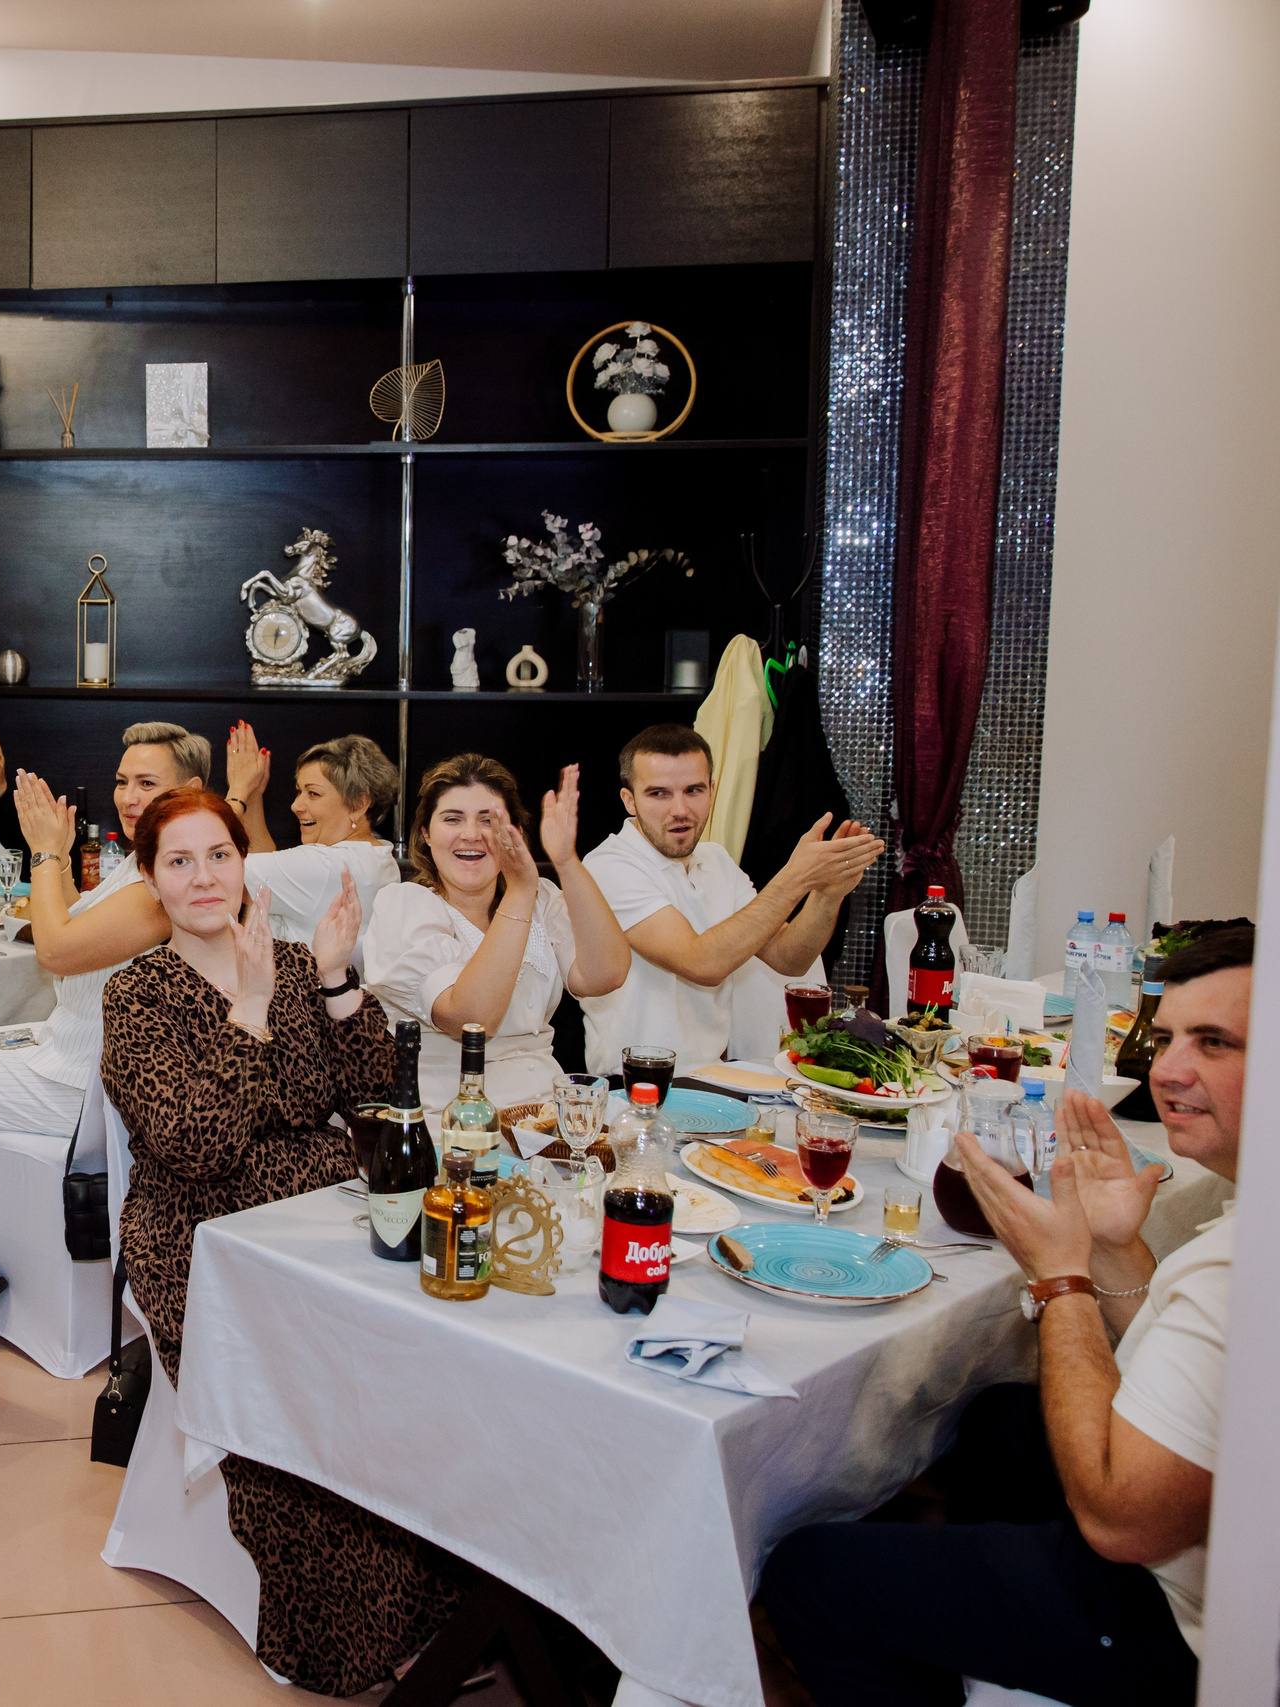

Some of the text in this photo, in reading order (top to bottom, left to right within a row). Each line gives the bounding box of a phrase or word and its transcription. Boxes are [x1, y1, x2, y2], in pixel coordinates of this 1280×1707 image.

[499, 1206, 542, 1260] 2
[625, 1241, 671, 1264] Добр
[646, 1264, 668, 1277] cola
